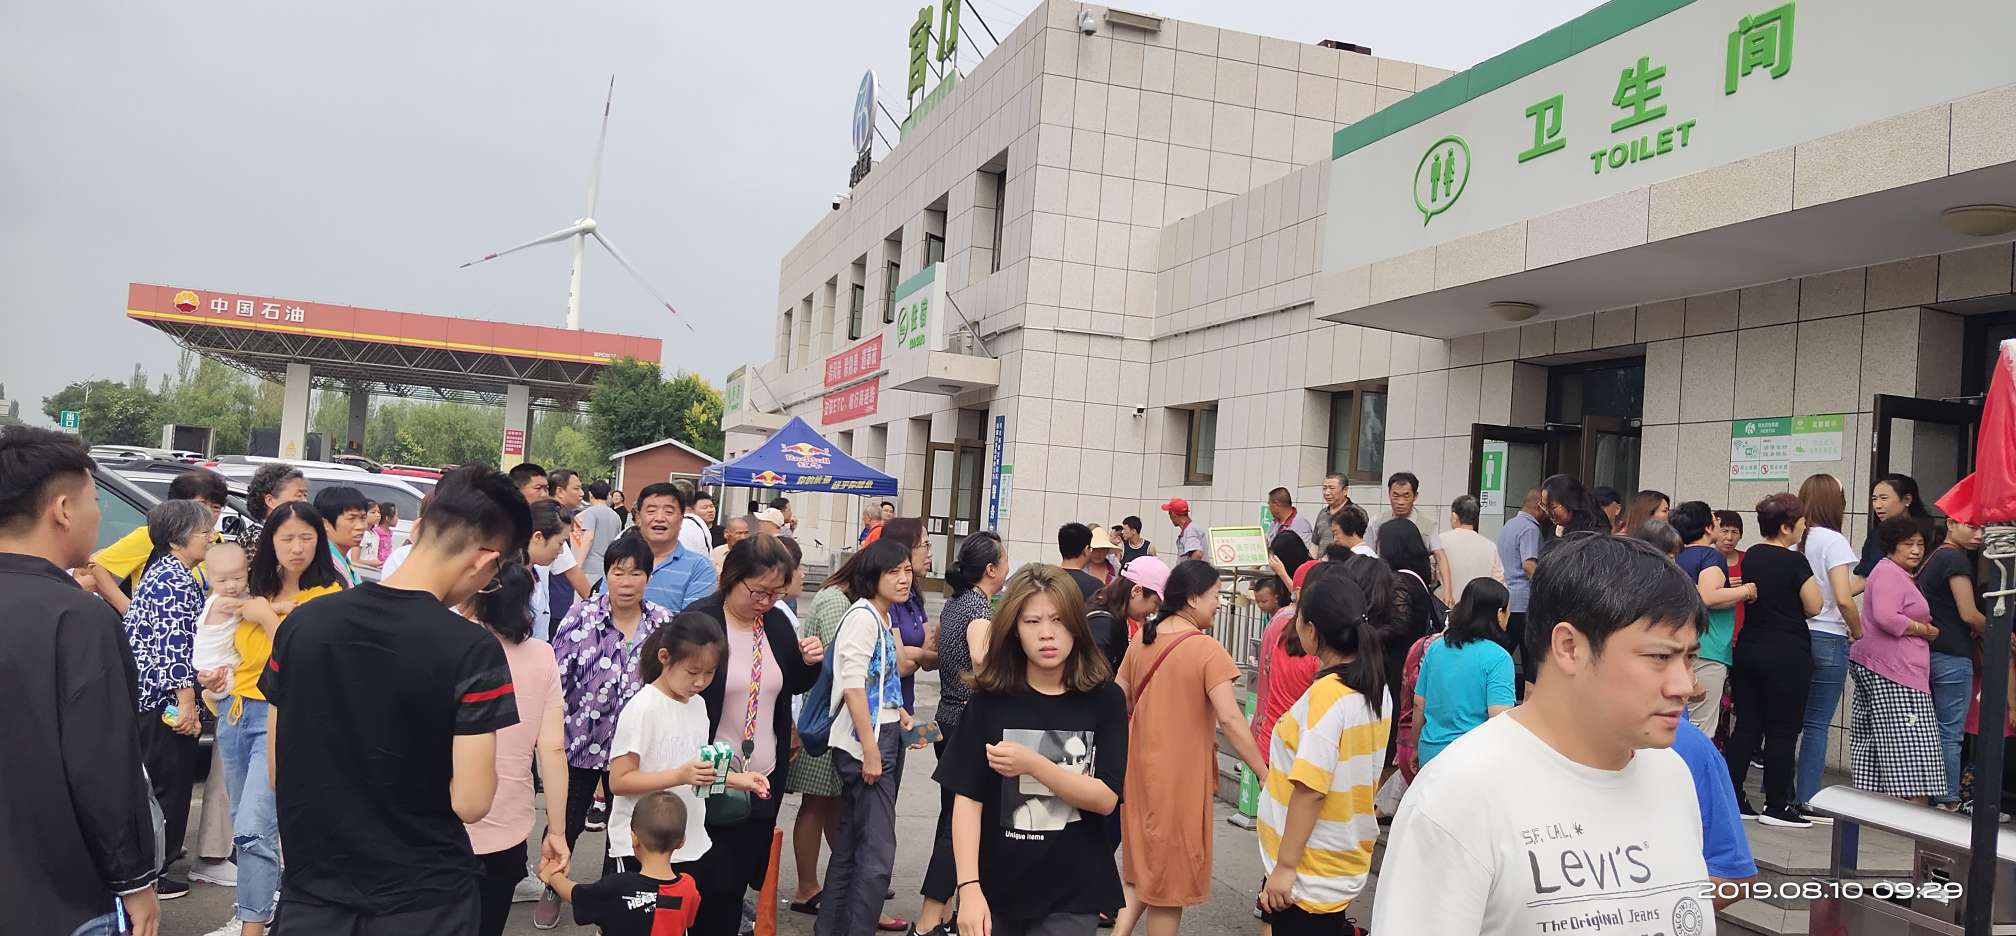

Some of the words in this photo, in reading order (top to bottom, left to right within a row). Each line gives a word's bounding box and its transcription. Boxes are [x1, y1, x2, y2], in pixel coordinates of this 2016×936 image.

[1518, 0, 1796, 164] 卫生间
[1590, 119, 1697, 174] TOILET
[210, 297, 305, 323] 中国石油
[66, 411, 75, 427] 出口
[1005, 830, 1025, 840] Unique
[1026, 833, 1045, 841] Items
[1528, 844, 1651, 894] Levi's
[1536, 918, 1568, 934] The
[1628, 908, 1661, 924] Jeans
